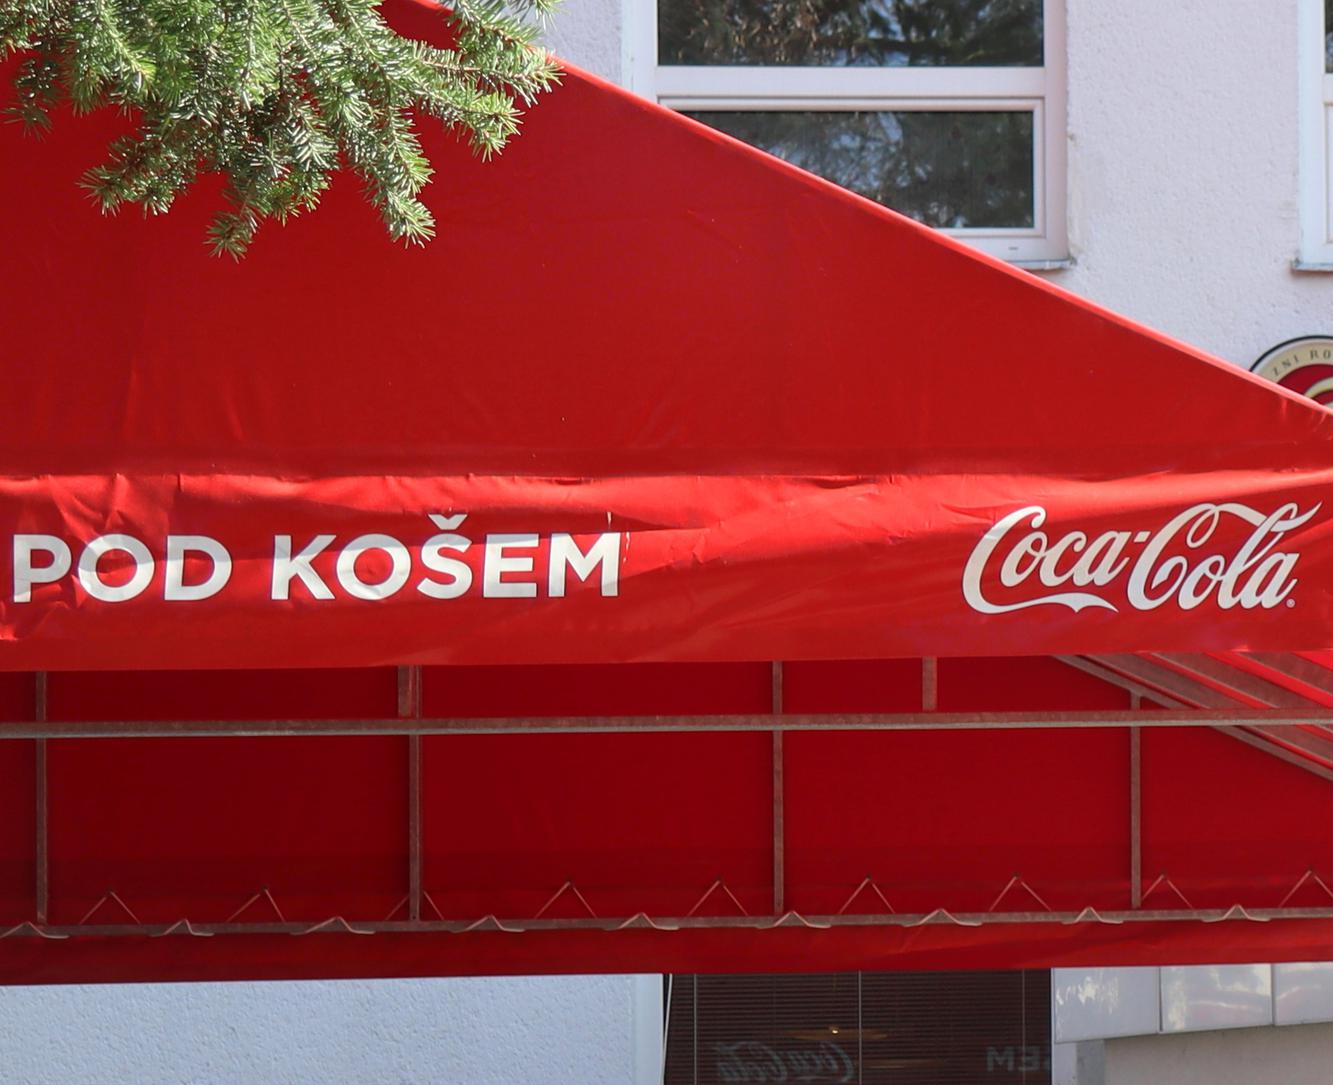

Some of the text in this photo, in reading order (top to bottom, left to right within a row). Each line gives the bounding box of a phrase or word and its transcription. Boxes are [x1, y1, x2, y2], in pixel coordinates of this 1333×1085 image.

[13, 513, 621, 604] POD KOŠEM
[962, 501, 1322, 614] Coca-Cola
